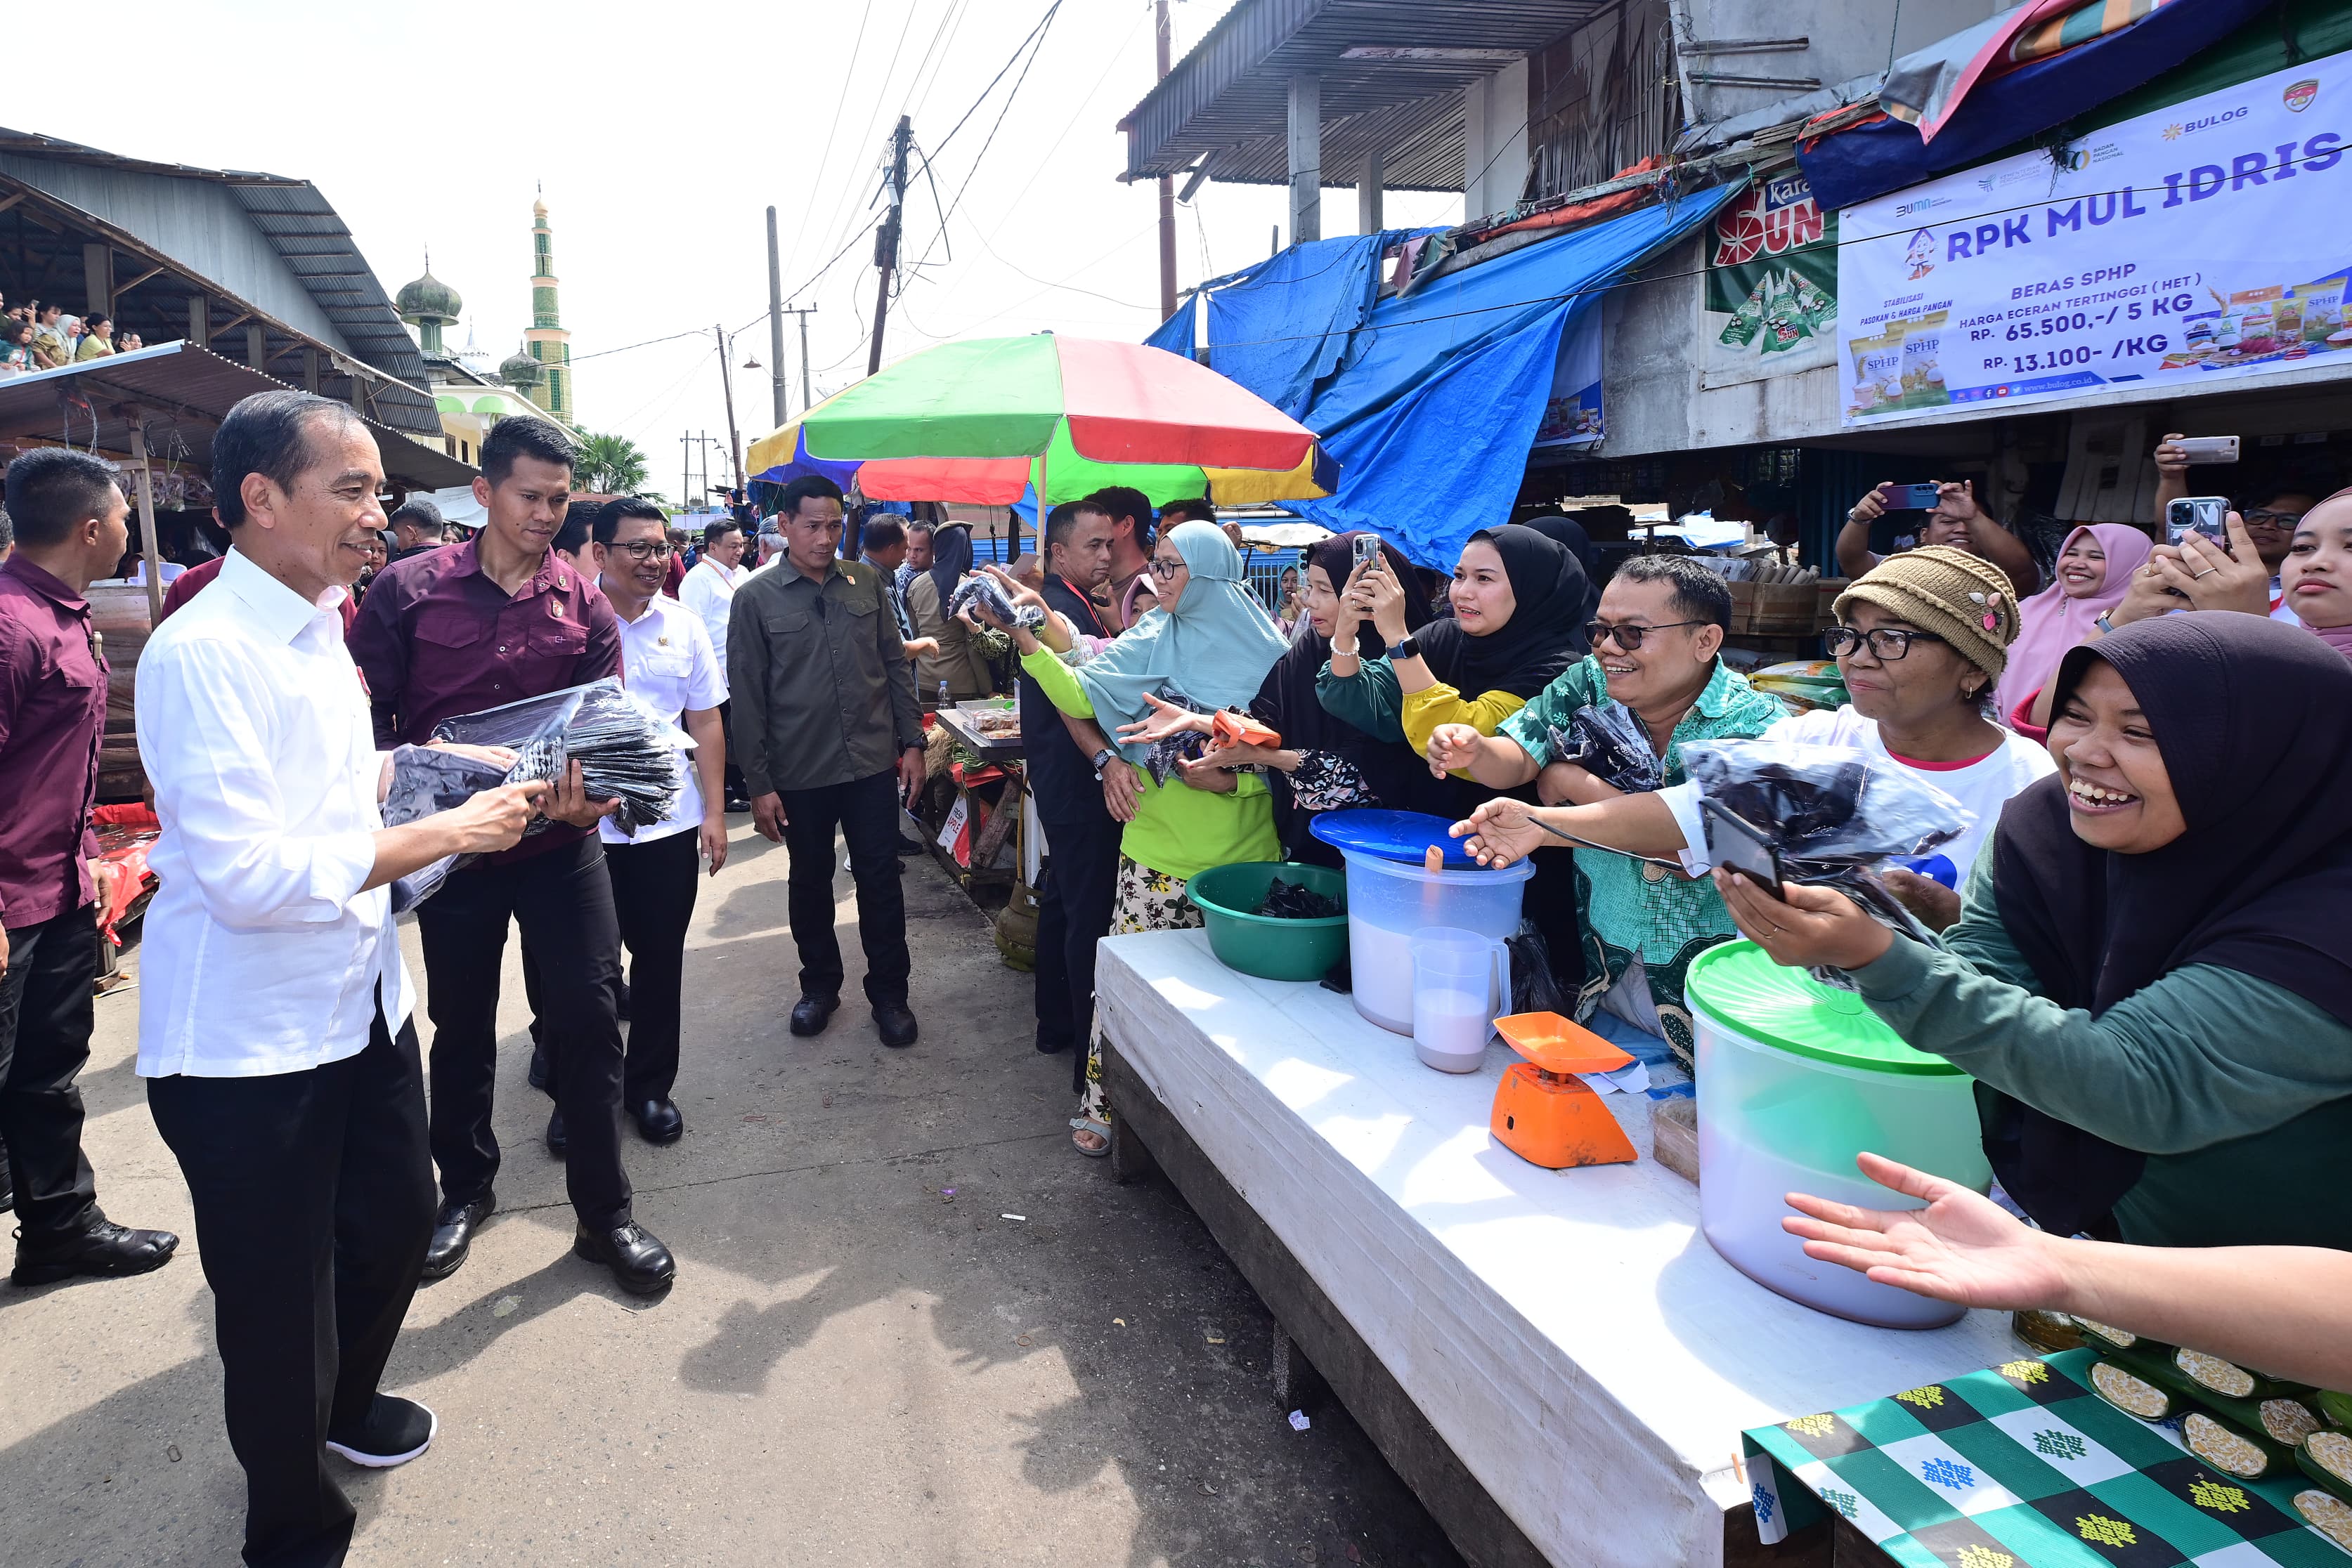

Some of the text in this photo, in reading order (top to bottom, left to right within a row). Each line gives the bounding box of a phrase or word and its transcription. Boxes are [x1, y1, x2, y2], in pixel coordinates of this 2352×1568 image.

[2184, 106, 2249, 133] BULOG
[2093, 143, 2114, 152] BADAN
[2093, 147, 2118, 158] PANGAN
[2093, 151, 2124, 164] NASIONAL
[1948, 133, 2343, 263] RPK MUL IDRIS
[2011, 263, 2136, 301] BERAS SPHP
[1883, 292, 1924, 308] STABILISASI
[1960, 313, 2003, 329] HARGA
[2008, 301, 2061, 320] ECERAN
[2066, 285, 2148, 309] TERTINGGI
[2162, 275, 2192, 291] HET
[2308, 296, 2339, 307] SPHP
[1860, 313, 1889, 326] PASOKAN
[1899, 306, 1921, 318] HARGA
[1923, 299, 1953, 313] PANGAN
[1971, 328, 1995, 341] RP.
[2128, 302, 2143, 320] 5
[2152, 293, 2193, 316] KG
[1905, 339, 1940, 354] SPHP
[1868, 356, 1899, 370] SPHP
[1984, 357, 2008, 370] RP.
[2024, 377, 2093, 392] www.bulog.co.id
[953, 807, 965, 822] FRESH
[947, 816, 961, 835] APPLE
